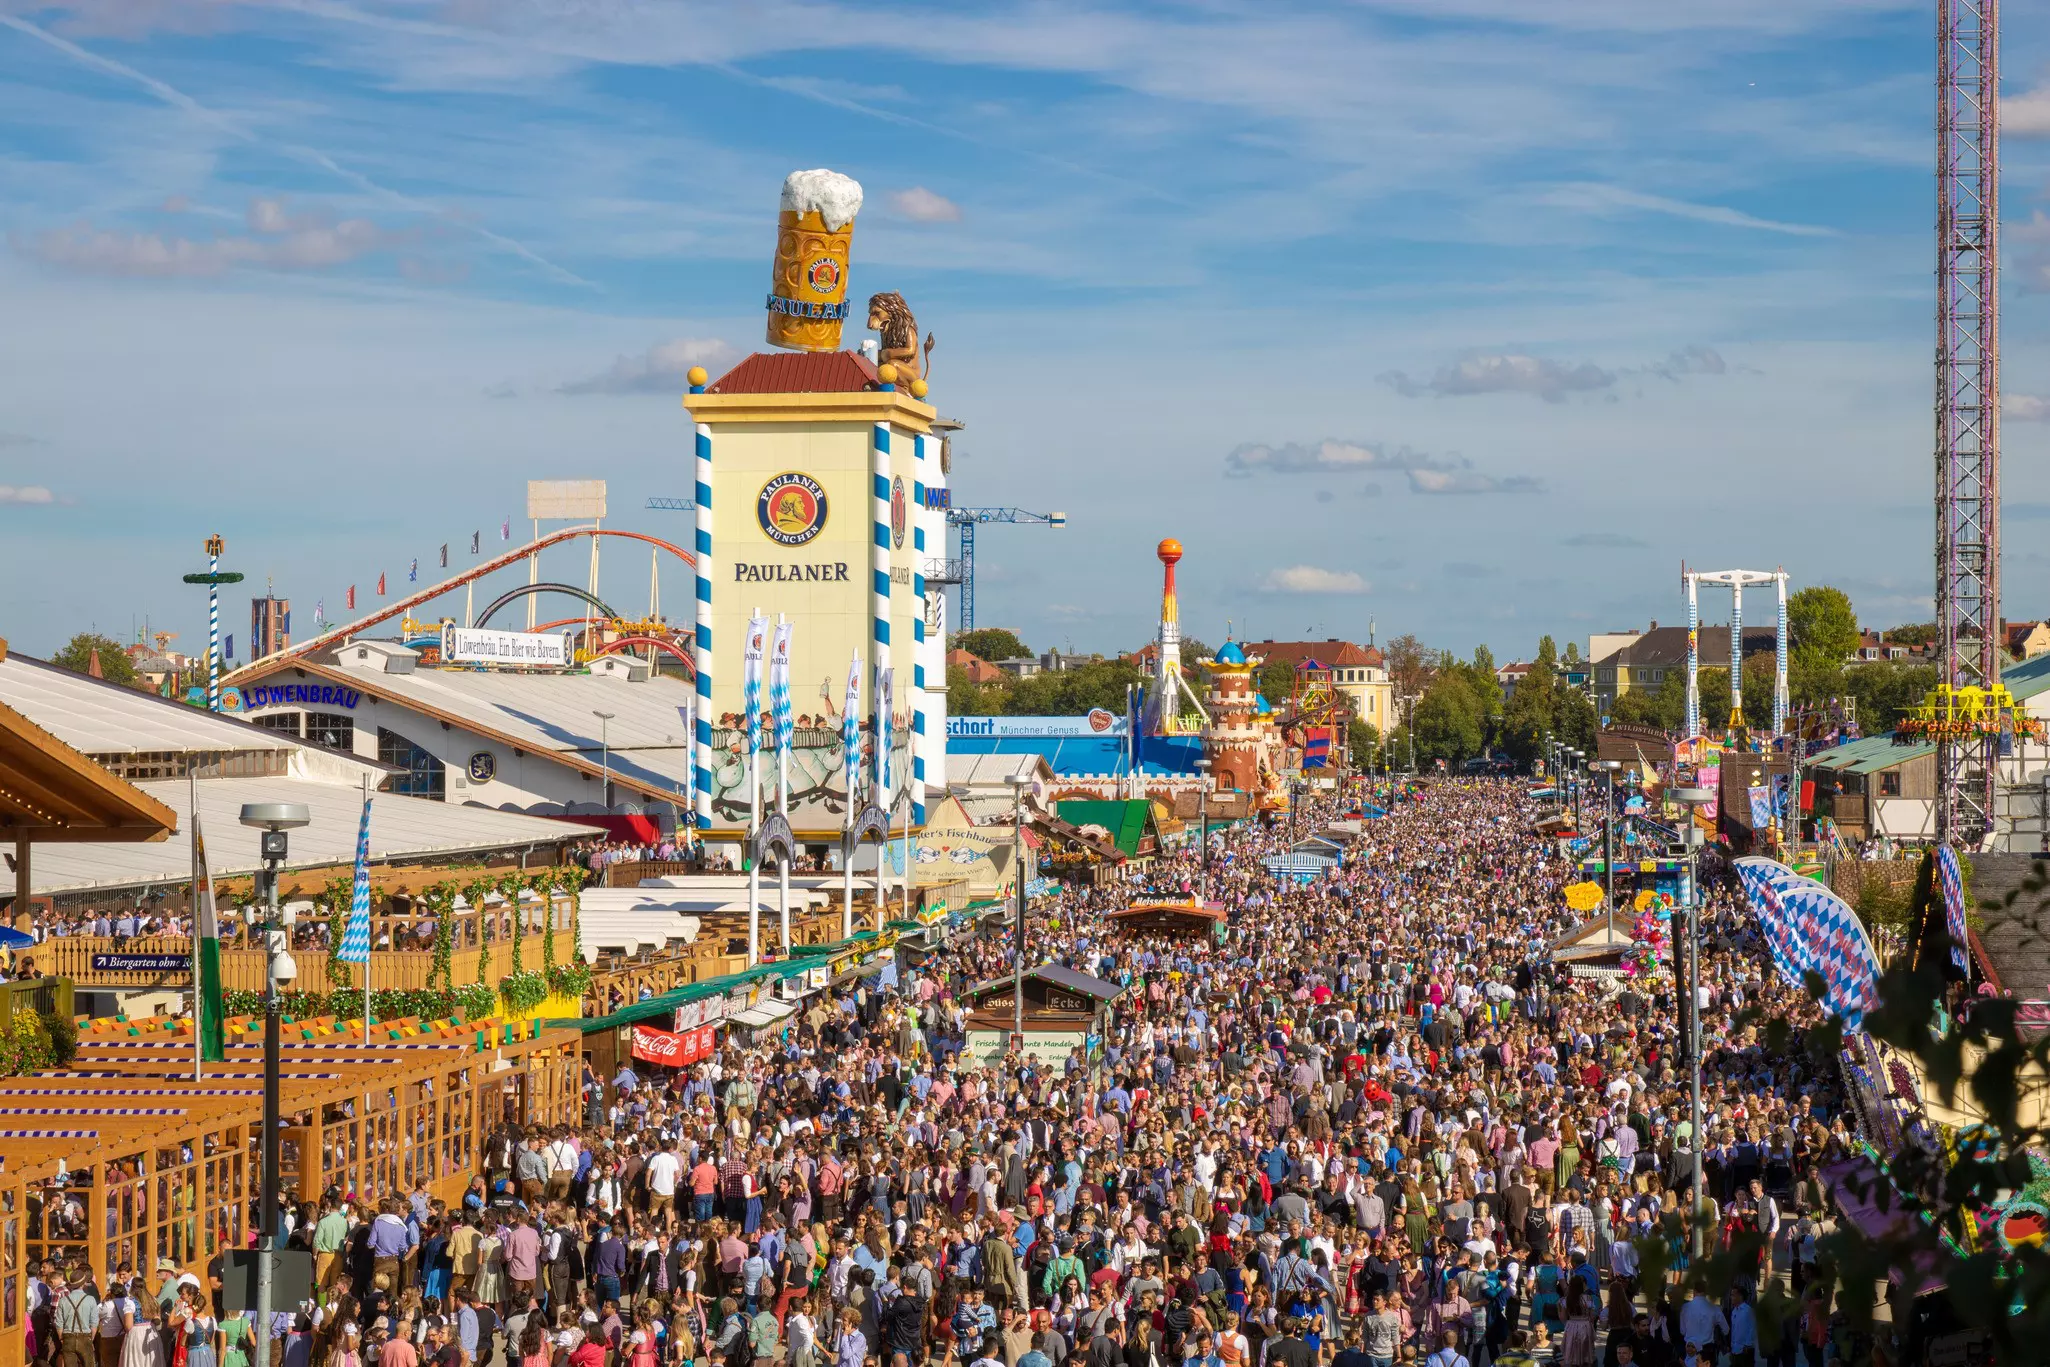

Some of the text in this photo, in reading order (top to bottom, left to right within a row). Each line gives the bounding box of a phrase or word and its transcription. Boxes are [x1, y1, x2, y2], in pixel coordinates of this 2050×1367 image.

[760, 474, 824, 502] PAULANER
[765, 525, 819, 544] MÜNCHEN
[734, 562, 850, 582] PAULANER
[889, 565, 910, 585] AULANER
[458, 634, 498, 656] Löwenbräu.
[499, 637, 510, 657] Ein
[511, 638, 525, 658] Bier
[525, 639, 537, 658] wie
[537, 639, 561, 663] Bayern.
[243, 684, 360, 709] LÖWENBRÄU
[1000, 725, 1044, 735] Münchner
[1047, 725, 1080, 735] Genuss
[947, 828, 991, 844] Fischhau
[109, 957, 156, 970] Biergarten
[158, 957, 180, 968] ohne
[1050, 998, 1081, 1009] Ecke
[1043, 1040, 1075, 1048] Mandeln
